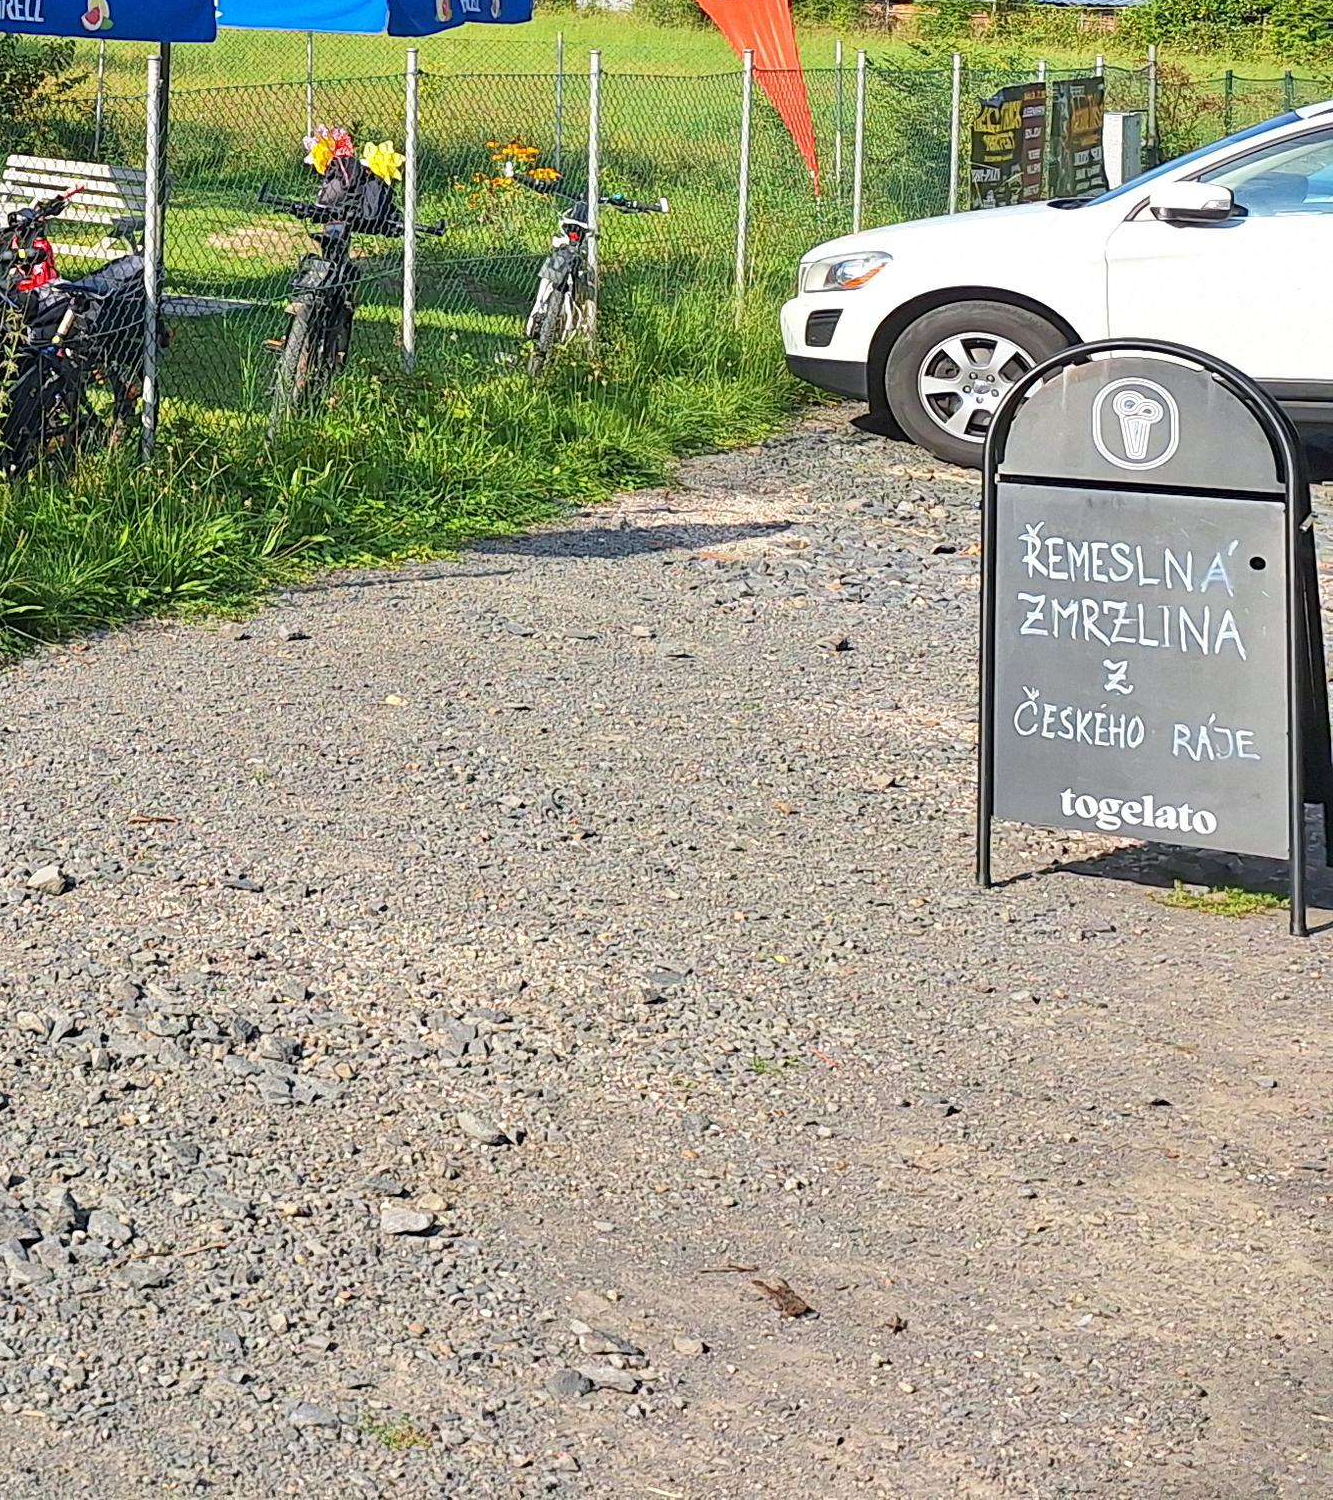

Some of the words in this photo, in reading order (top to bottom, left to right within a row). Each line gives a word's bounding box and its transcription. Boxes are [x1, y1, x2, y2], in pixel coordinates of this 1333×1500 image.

[1018, 521, 1241, 597] ŘEMESLNÁ
[1018, 592, 1248, 661] ZMRZLINA
[1013, 686, 1145, 751] ČESKÉHO
[1171, 712, 1261, 762] RÁJE
[1060, 788, 1218, 836] togelato
